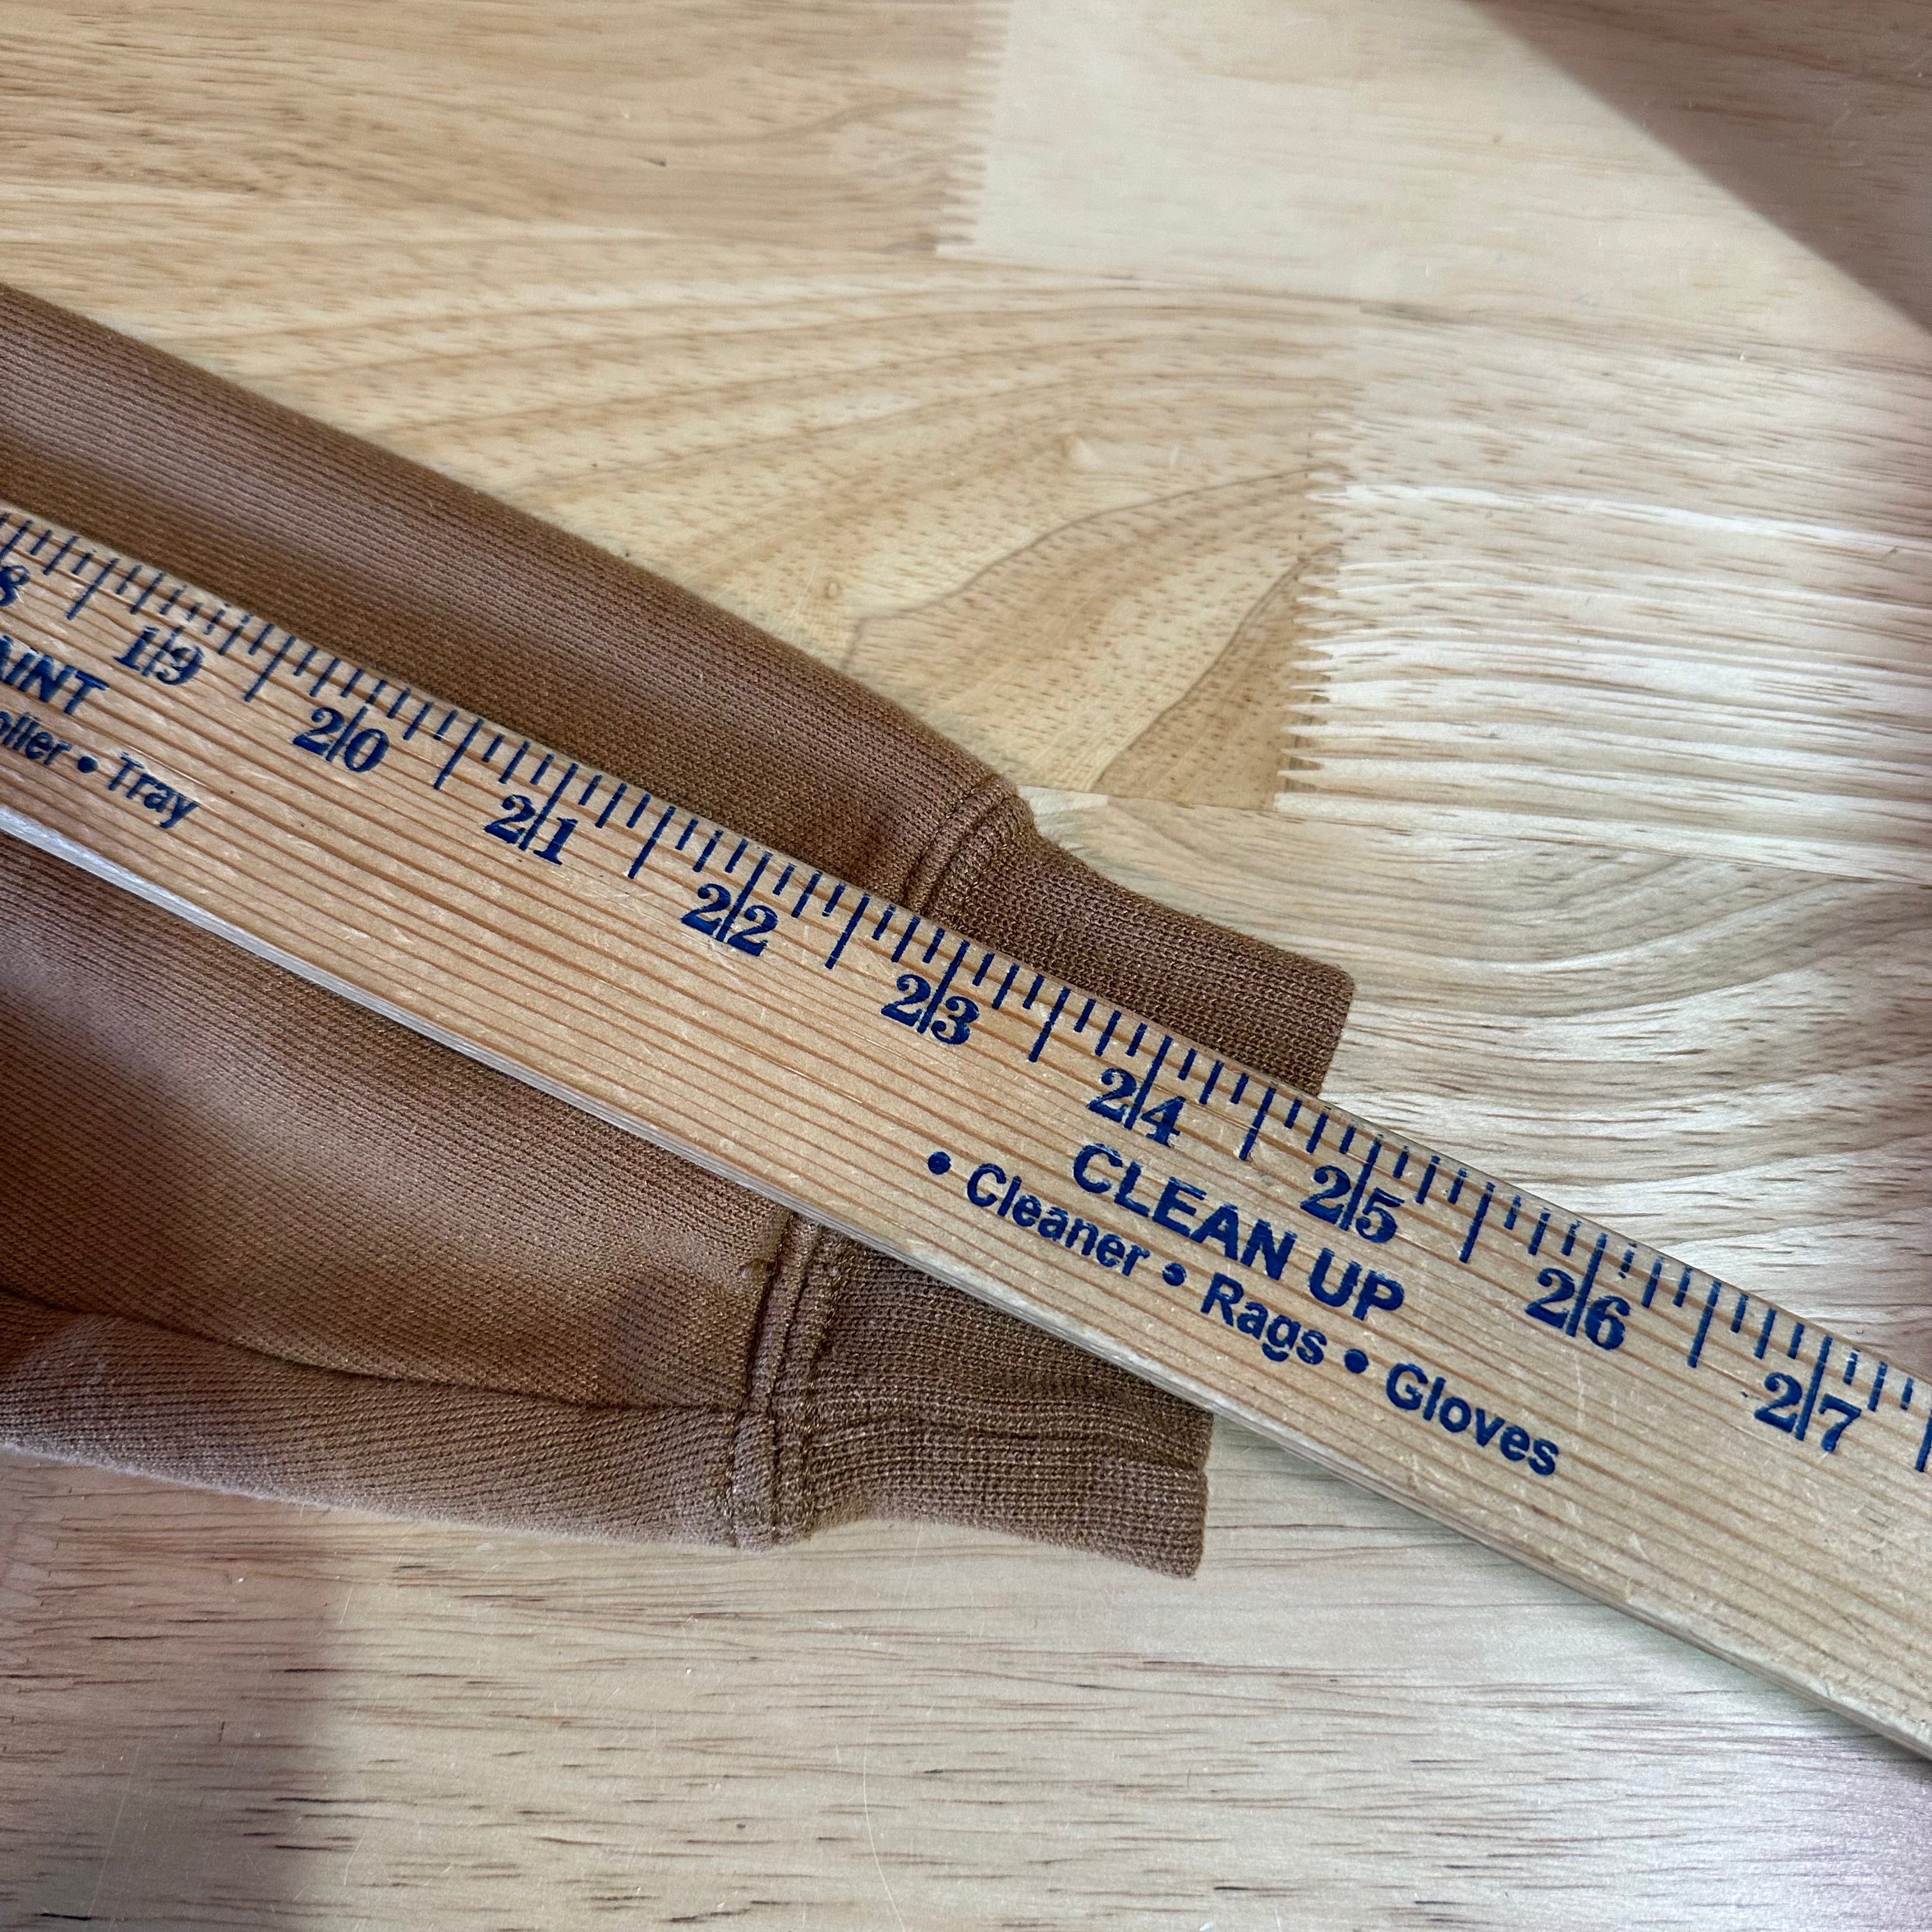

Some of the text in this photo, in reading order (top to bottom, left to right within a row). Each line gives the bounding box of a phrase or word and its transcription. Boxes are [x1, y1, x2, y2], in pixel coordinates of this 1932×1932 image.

[114, 625, 205, 686] 19
[293, 705, 390, 773] 20
[107, 752, 201, 829] Tray
[484, 794, 578, 866] 21
[680, 883, 778, 956] 22
[880, 974, 980, 1045] 23
[1087, 1068, 1182, 1148] 24
[1073, 1144, 1405, 1321] CLEAN UP
[1300, 1164, 1405, 1243] 25
[967, 1163, 1560, 1476] Cleaner Rags Gloves
[1525, 1268, 1630, 1350] 26
[1754, 1372, 1862, 1453] 27
